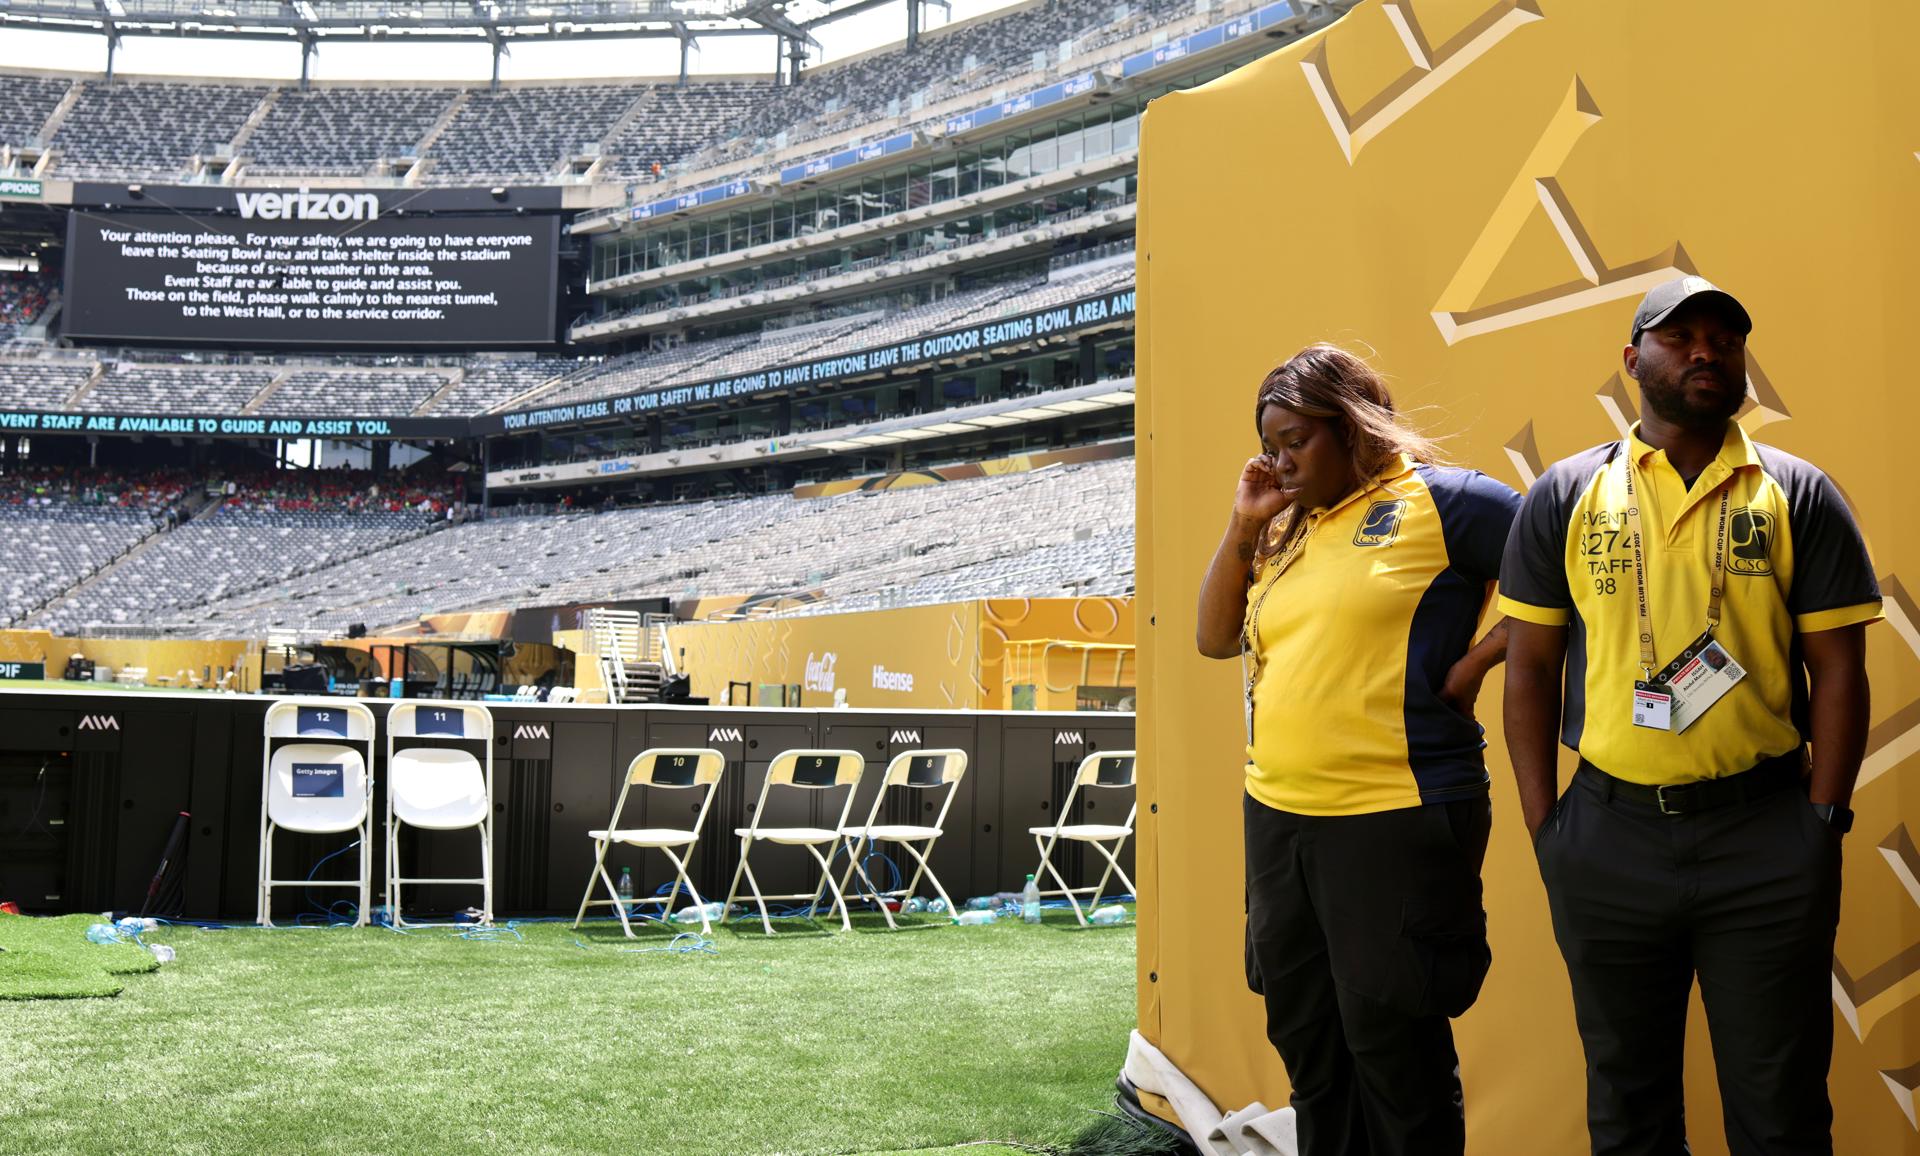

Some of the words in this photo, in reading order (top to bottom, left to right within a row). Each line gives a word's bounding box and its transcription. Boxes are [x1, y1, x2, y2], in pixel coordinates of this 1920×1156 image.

[235, 187, 379, 220] verizon
[100, 229, 131, 242] Your
[134, 232, 191, 244] attention
[194, 232, 239, 246] please.
[246, 233, 267, 245] For
[270, 236, 299, 248] your
[302, 234, 342, 248] safety,
[345, 237, 364, 246] we
[367, 237, 386, 246] are
[389, 235, 425, 248] going
[428, 236, 441, 246] to
[445, 234, 473, 246] have
[476, 235, 532, 247] everyone
[121, 244, 154, 257] leave
[157, 245, 178, 258] the
[181, 246, 228, 261] Seating
[232, 247, 261, 259] Bowl
[264, 250, 291, 260] area
[294, 248, 319, 260] and
[322, 249, 349, 261] take
[351, 249, 394, 260] shelter
[398, 249, 434, 260] inside
[437, 249, 457, 260] the
[460, 248, 511, 260] stadium
[196, 261, 248, 274] because
[251, 262, 266, 275] of
[311, 264, 361, 275] weather
[364, 264, 376, 275] in
[379, 264, 399, 275] the
[402, 266, 433, 276] area.
[165, 275, 199, 287] Event
[202, 276, 231, 288] Staff
[234, 279, 255, 288] are
[257, 277, 313, 289] avlable
[316, 279, 329, 289] to
[332, 278, 367, 291] guide
[370, 278, 394, 289] and
[397, 278, 432, 290] assist
[435, 281, 461, 291] you.
[125, 288, 165, 301] Those
[168, 291, 185, 301] on
[188, 289, 209, 302] the
[212, 290, 244, 303] field,
[247, 290, 287, 305] please
[290, 292, 320, 303] walk
[323, 292, 363, 306] calmly
[366, 294, 379, 304] to
[383, 293, 403, 304] the
[406, 294, 451, 304] nearest
[454, 293, 498, 305] tunnel,
[183, 306, 197, 317] to
[199, 305, 220, 317] the
[223, 306, 254, 318] West
[257, 306, 286, 319] Hall,
[289, 309, 303, 318] or
[305, 308, 319, 318] to
[322, 308, 342, 319] the
[345, 308, 388, 319] service
[392, 307, 445, 319] corridor.
[504, 414, 526, 428] YOUR
[528, 408, 575, 425] ATTENTION
[576, 404, 609, 420] PLEASE.
[614, 398, 631, 413] FOR
[634, 394, 658, 410] YOUR
[661, 387, 692, 406] SAFETY
[694, 384, 710, 400] WE
[713, 381, 731, 397] ARE
[734, 376, 766, 395] GOING
[768, 372, 781, 387] TO
[784, 365, 810, 385] HAVE
[812, 355, 866, 381] EVERYONE
[869, 348, 899, 369] LEAVE
[901, 344, 920, 361] THE
[923, 330, 980, 359] OUTDOOR
[983, 318, 1032, 345] SEATING
[1036, 309, 1071, 332] BOWL
[1074, 299, 1108, 325] AREA
[42, 414, 82, 429] STAFF
[87, 416, 116, 431] ARE
[119, 417, 193, 432] AVAILABLE
[198, 418, 217, 433] TO
[221, 419, 265, 434] GUIDE
[269, 420, 302, 434] AND
[306, 420, 352, 435] ASSIST
[357, 420, 391, 435] YOU.
[1718, 516, 1726, 537] WORLD
[1716, 538, 1724, 551] CUP
[1587, 559, 1633, 576] TAFF
[1735, 558, 1768, 571] CSC
[1636, 562, 1644, 586] WORLD
[1594, 577, 1617, 596] 98
[872, 664, 914, 692] Hisense
[316, 712, 330, 722] 12
[434, 712, 446, 722] 11
[673, 757, 685, 767] 10
[815, 758, 822, 768] 9
[926, 758, 933, 768] 8
[1115, 759, 1122, 768] 7
[296, 768, 313, 776] Getty
[314, 768, 337, 776] Images
